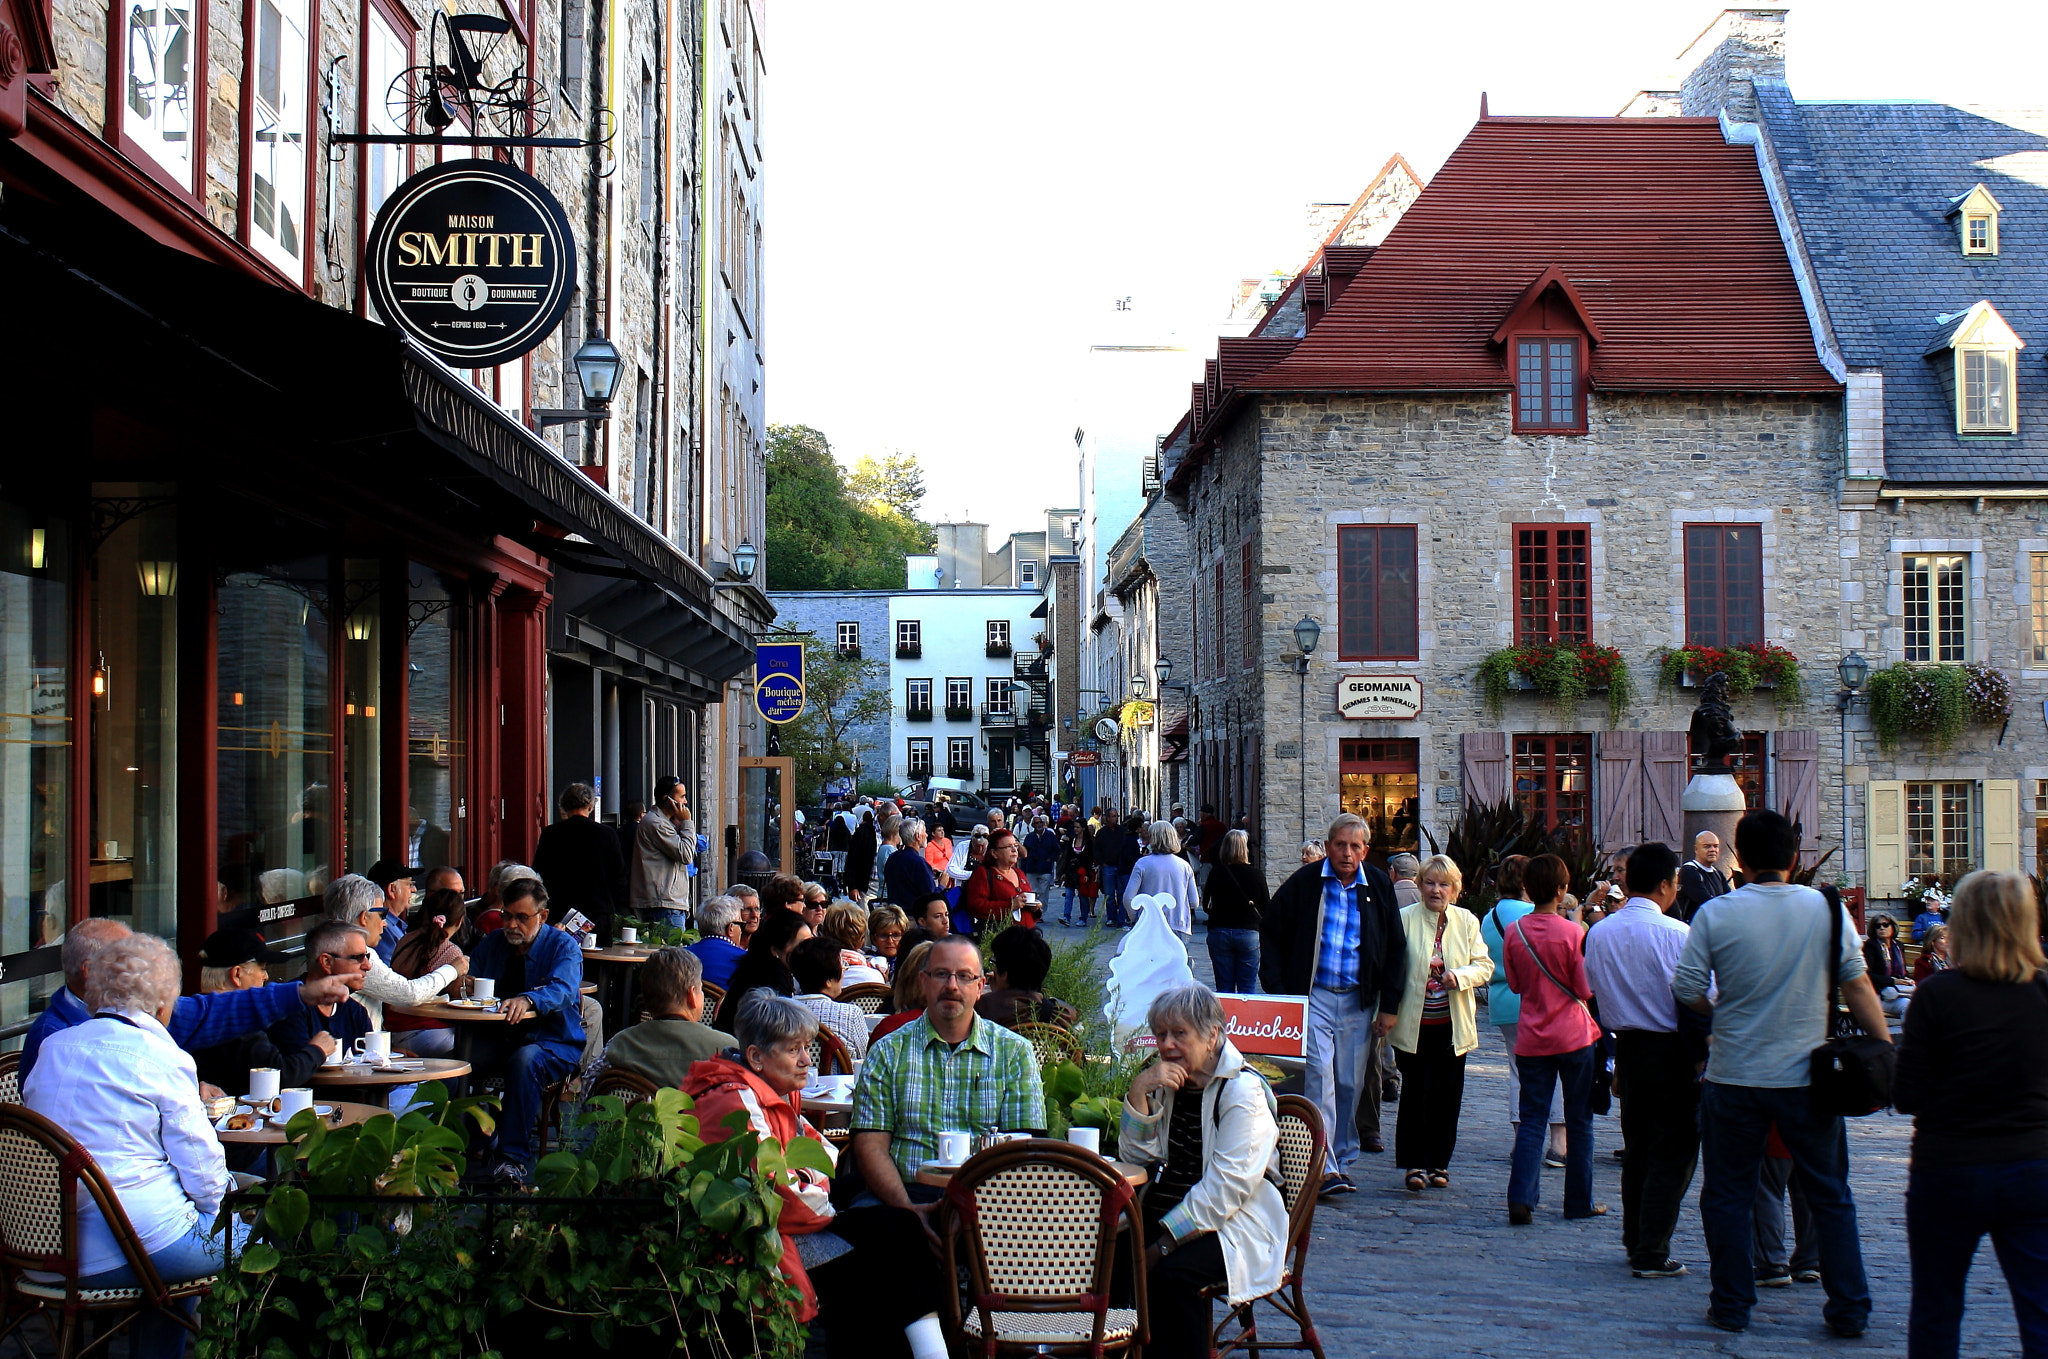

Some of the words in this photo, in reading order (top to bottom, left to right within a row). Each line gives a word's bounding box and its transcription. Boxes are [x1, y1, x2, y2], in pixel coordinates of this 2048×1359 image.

[448, 215, 494, 228] MAISON
[398, 232, 545, 267] SMITH
[411, 287, 448, 298] BOUTIQUE
[491, 289, 537, 299] GOURMANDE
[451, 321, 472, 329] DEPUIS
[765, 687, 801, 699] Boutique
[1349, 683, 1412, 692] GEOMANIA
[776, 698, 802, 706] métiers
[1342, 696, 1371, 711] GEMMES
[1381, 696, 1418, 710] MINERAUX
[767, 707, 783, 716] d'art
[1226, 1015, 1304, 1040] dwiches
